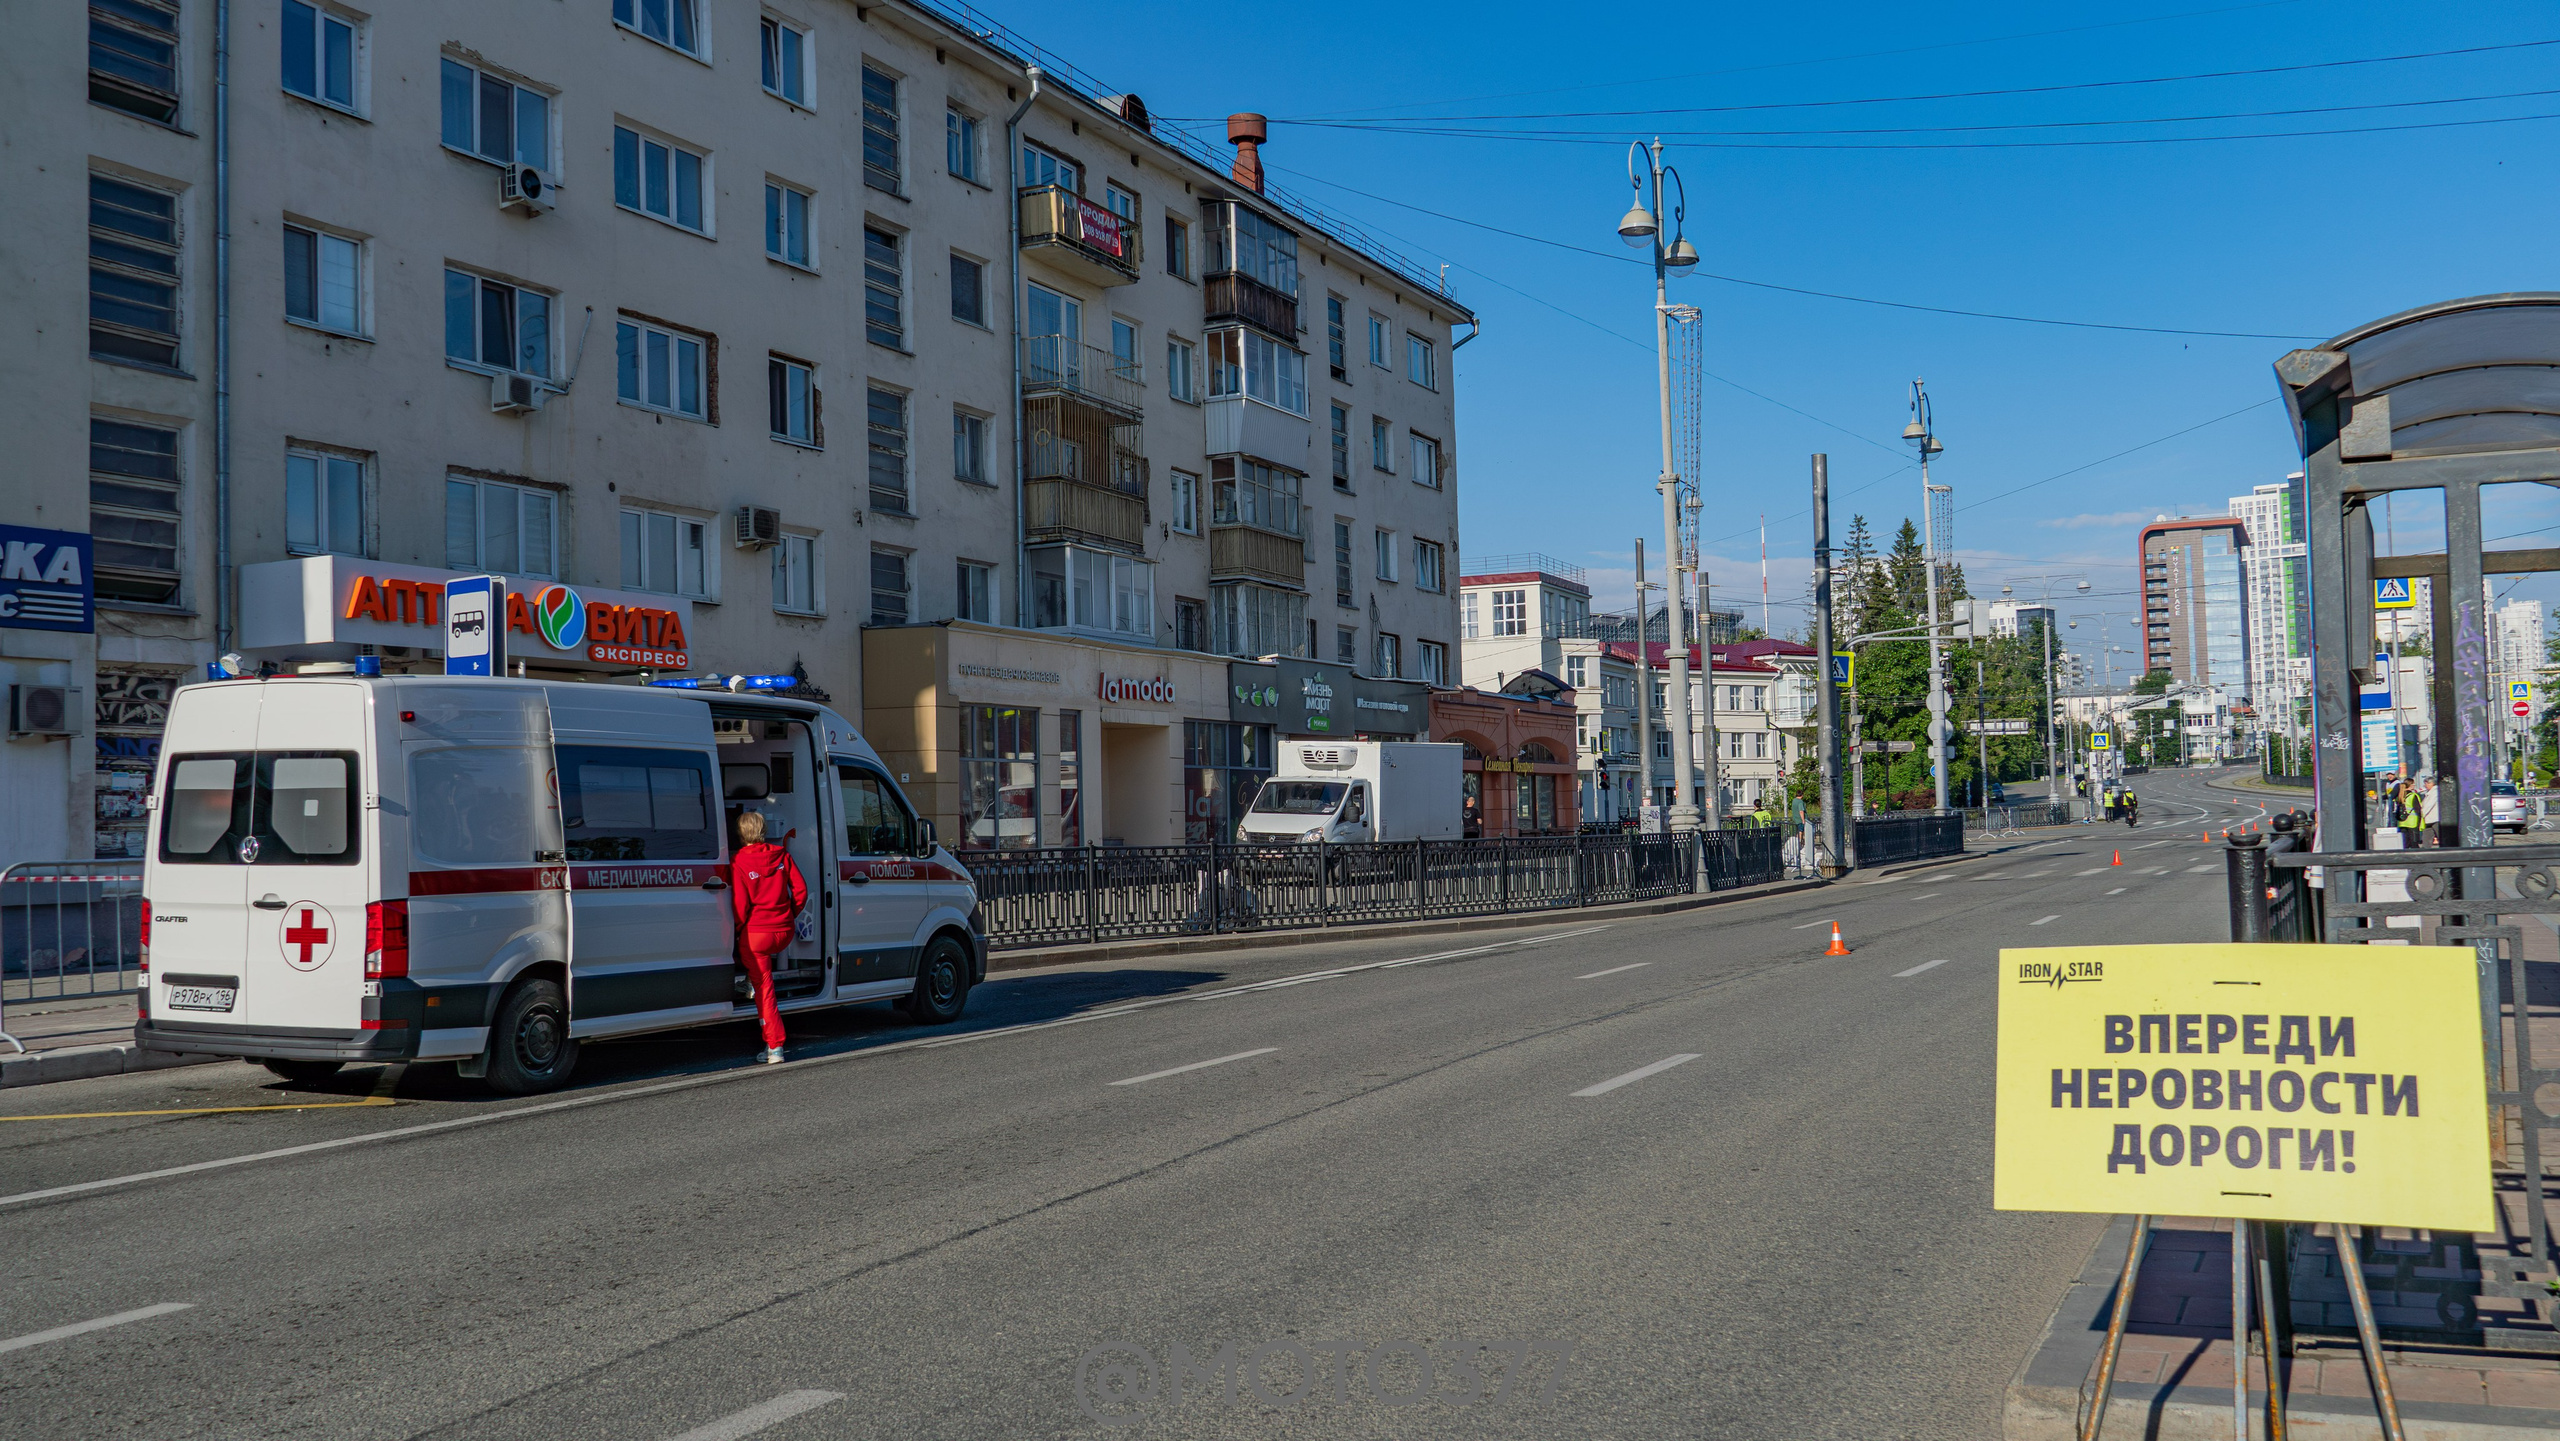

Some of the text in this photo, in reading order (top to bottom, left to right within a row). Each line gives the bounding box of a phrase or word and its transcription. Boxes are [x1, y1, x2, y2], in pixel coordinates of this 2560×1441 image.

[345, 576, 688, 649] АПТА ВИТА
[595, 647, 687, 667] ЭКСПРЕСС
[1100, 671, 1176, 703] lamoda
[830, 730, 838, 745] 2
[588, 868, 694, 889] МЕДИЦИНСКАЯ
[870, 864, 915, 880] ПОМОЩЬ
[2019, 961, 2103, 978] IRON STAR
[2104, 1013, 2355, 1064] ВПЕРЕДИ
[2051, 1068, 2420, 1118] НЕРОВНОСТИ
[2107, 1123, 2357, 1174] ДОРОГИ!
